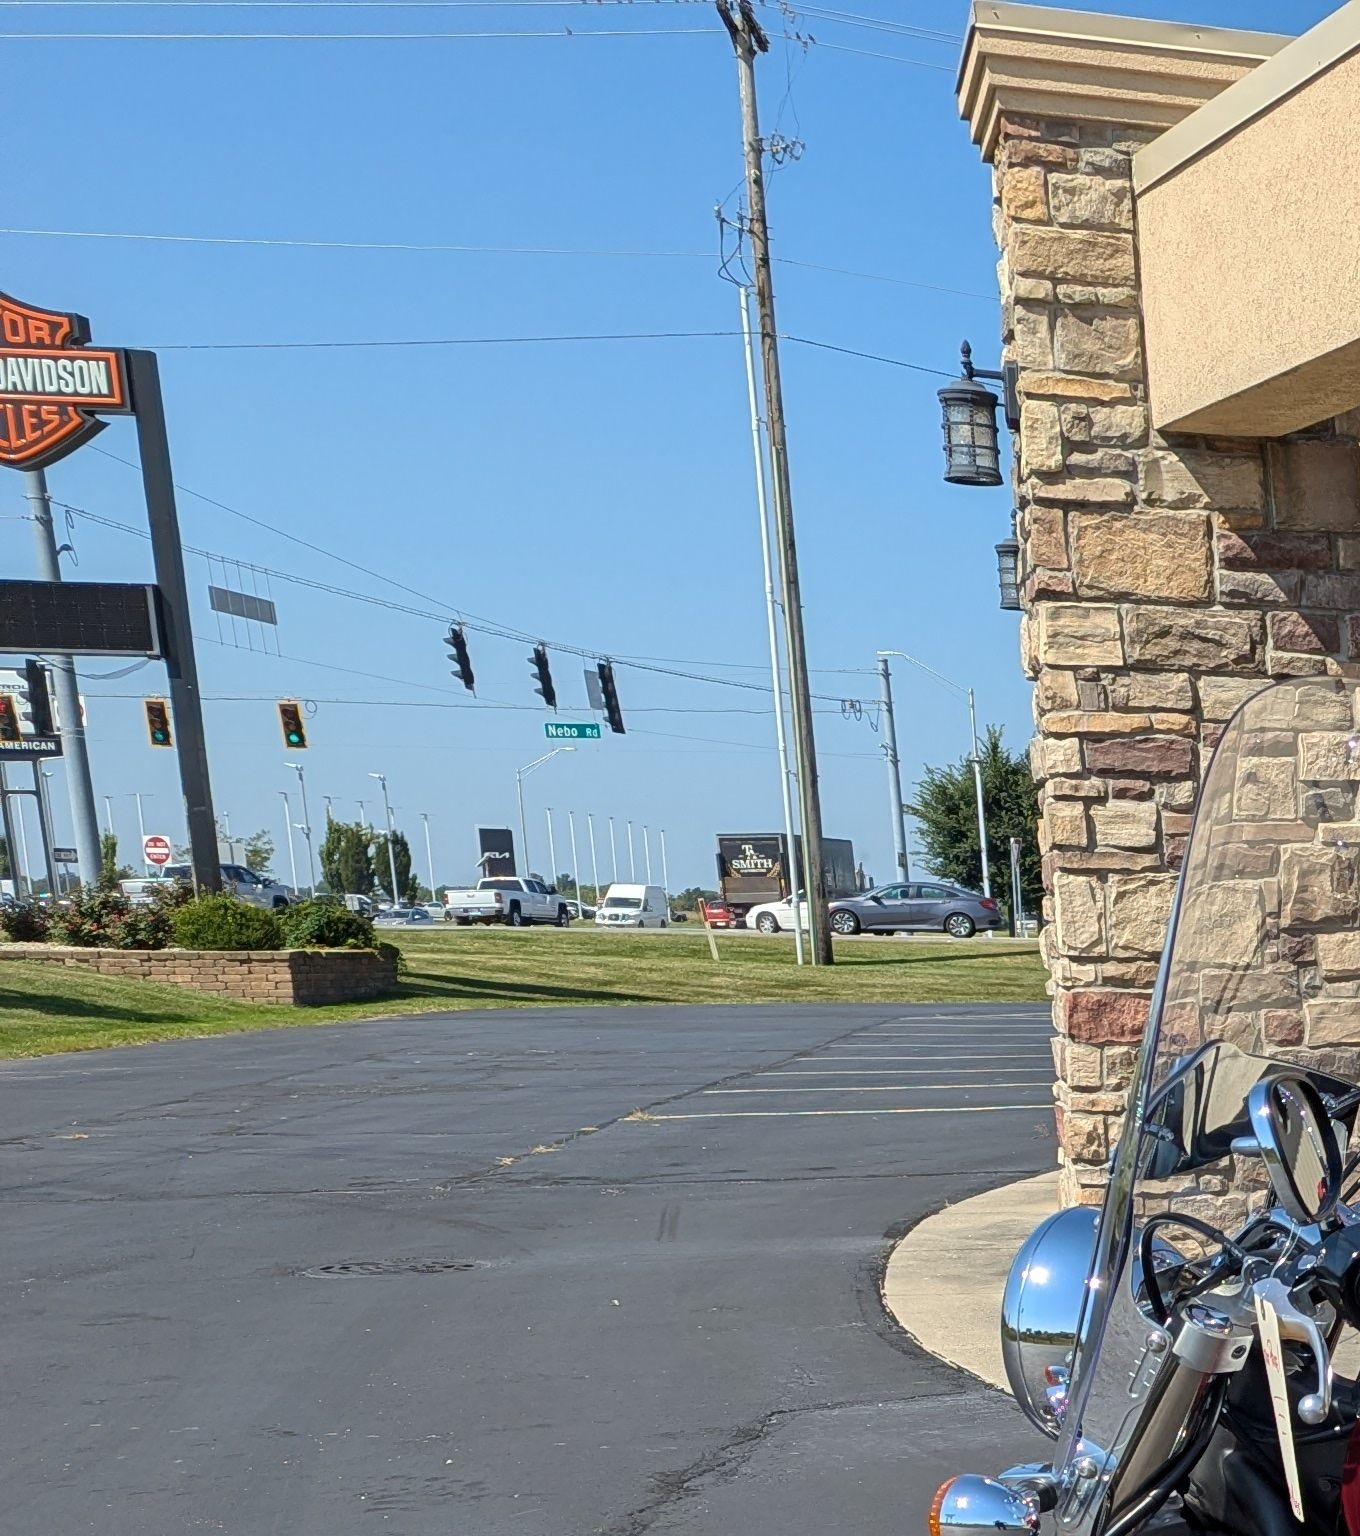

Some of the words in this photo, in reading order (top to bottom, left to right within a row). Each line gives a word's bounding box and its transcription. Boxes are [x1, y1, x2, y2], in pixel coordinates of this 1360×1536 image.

[547, 724, 578, 737] Nebo
[585, 727, 599, 738] Rd
[731, 858, 773, 869] SMITH
